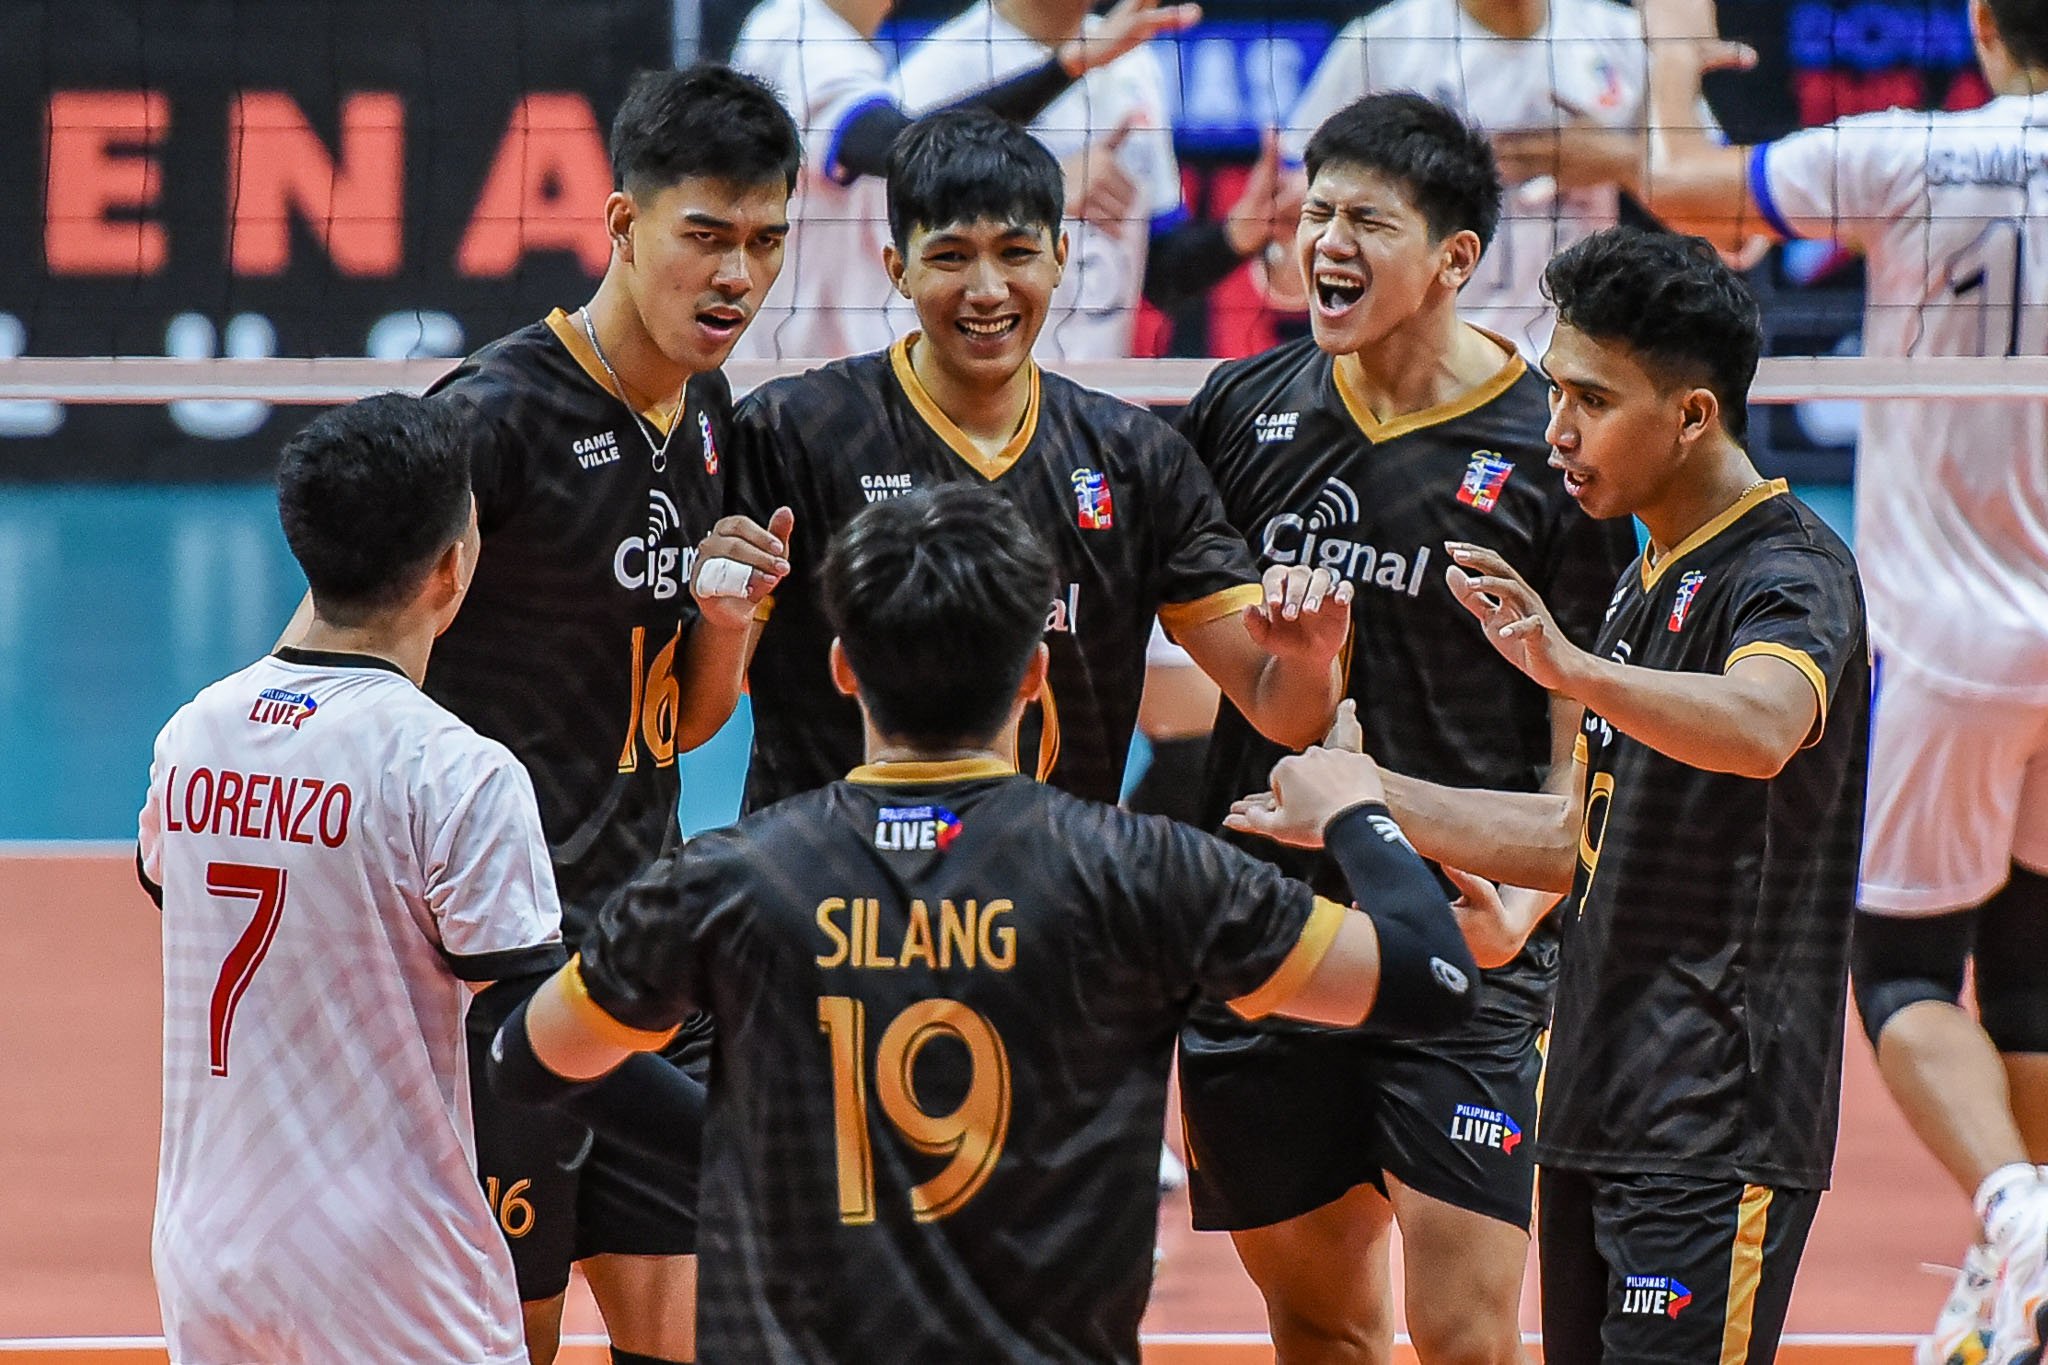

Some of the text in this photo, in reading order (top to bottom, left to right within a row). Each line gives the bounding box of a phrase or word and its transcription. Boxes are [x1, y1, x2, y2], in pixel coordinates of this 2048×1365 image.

[1255, 412, 1299, 427] GAME
[573, 430, 616, 454] GAME
[578, 446, 620, 469] VILLE
[861, 473, 912, 488] GAME
[1263, 512, 1431, 597] Cignal
[618, 619, 682, 774] 16
[249, 698, 299, 725] LIVE
[167, 765, 352, 849] LORENZO
[875, 821, 936, 850] LIVE
[816, 897, 1017, 971] SILANG
[206, 862, 288, 1077] 7
[817, 996, 1013, 1224] 19
[1456, 1104, 1503, 1123] PILIPINAS
[1450, 1116, 1503, 1148] LIVE
[485, 1176, 536, 1238] 16
[1626, 1276, 1666, 1289] PILIPINAS
[1622, 1289, 1667, 1315] LIVE
